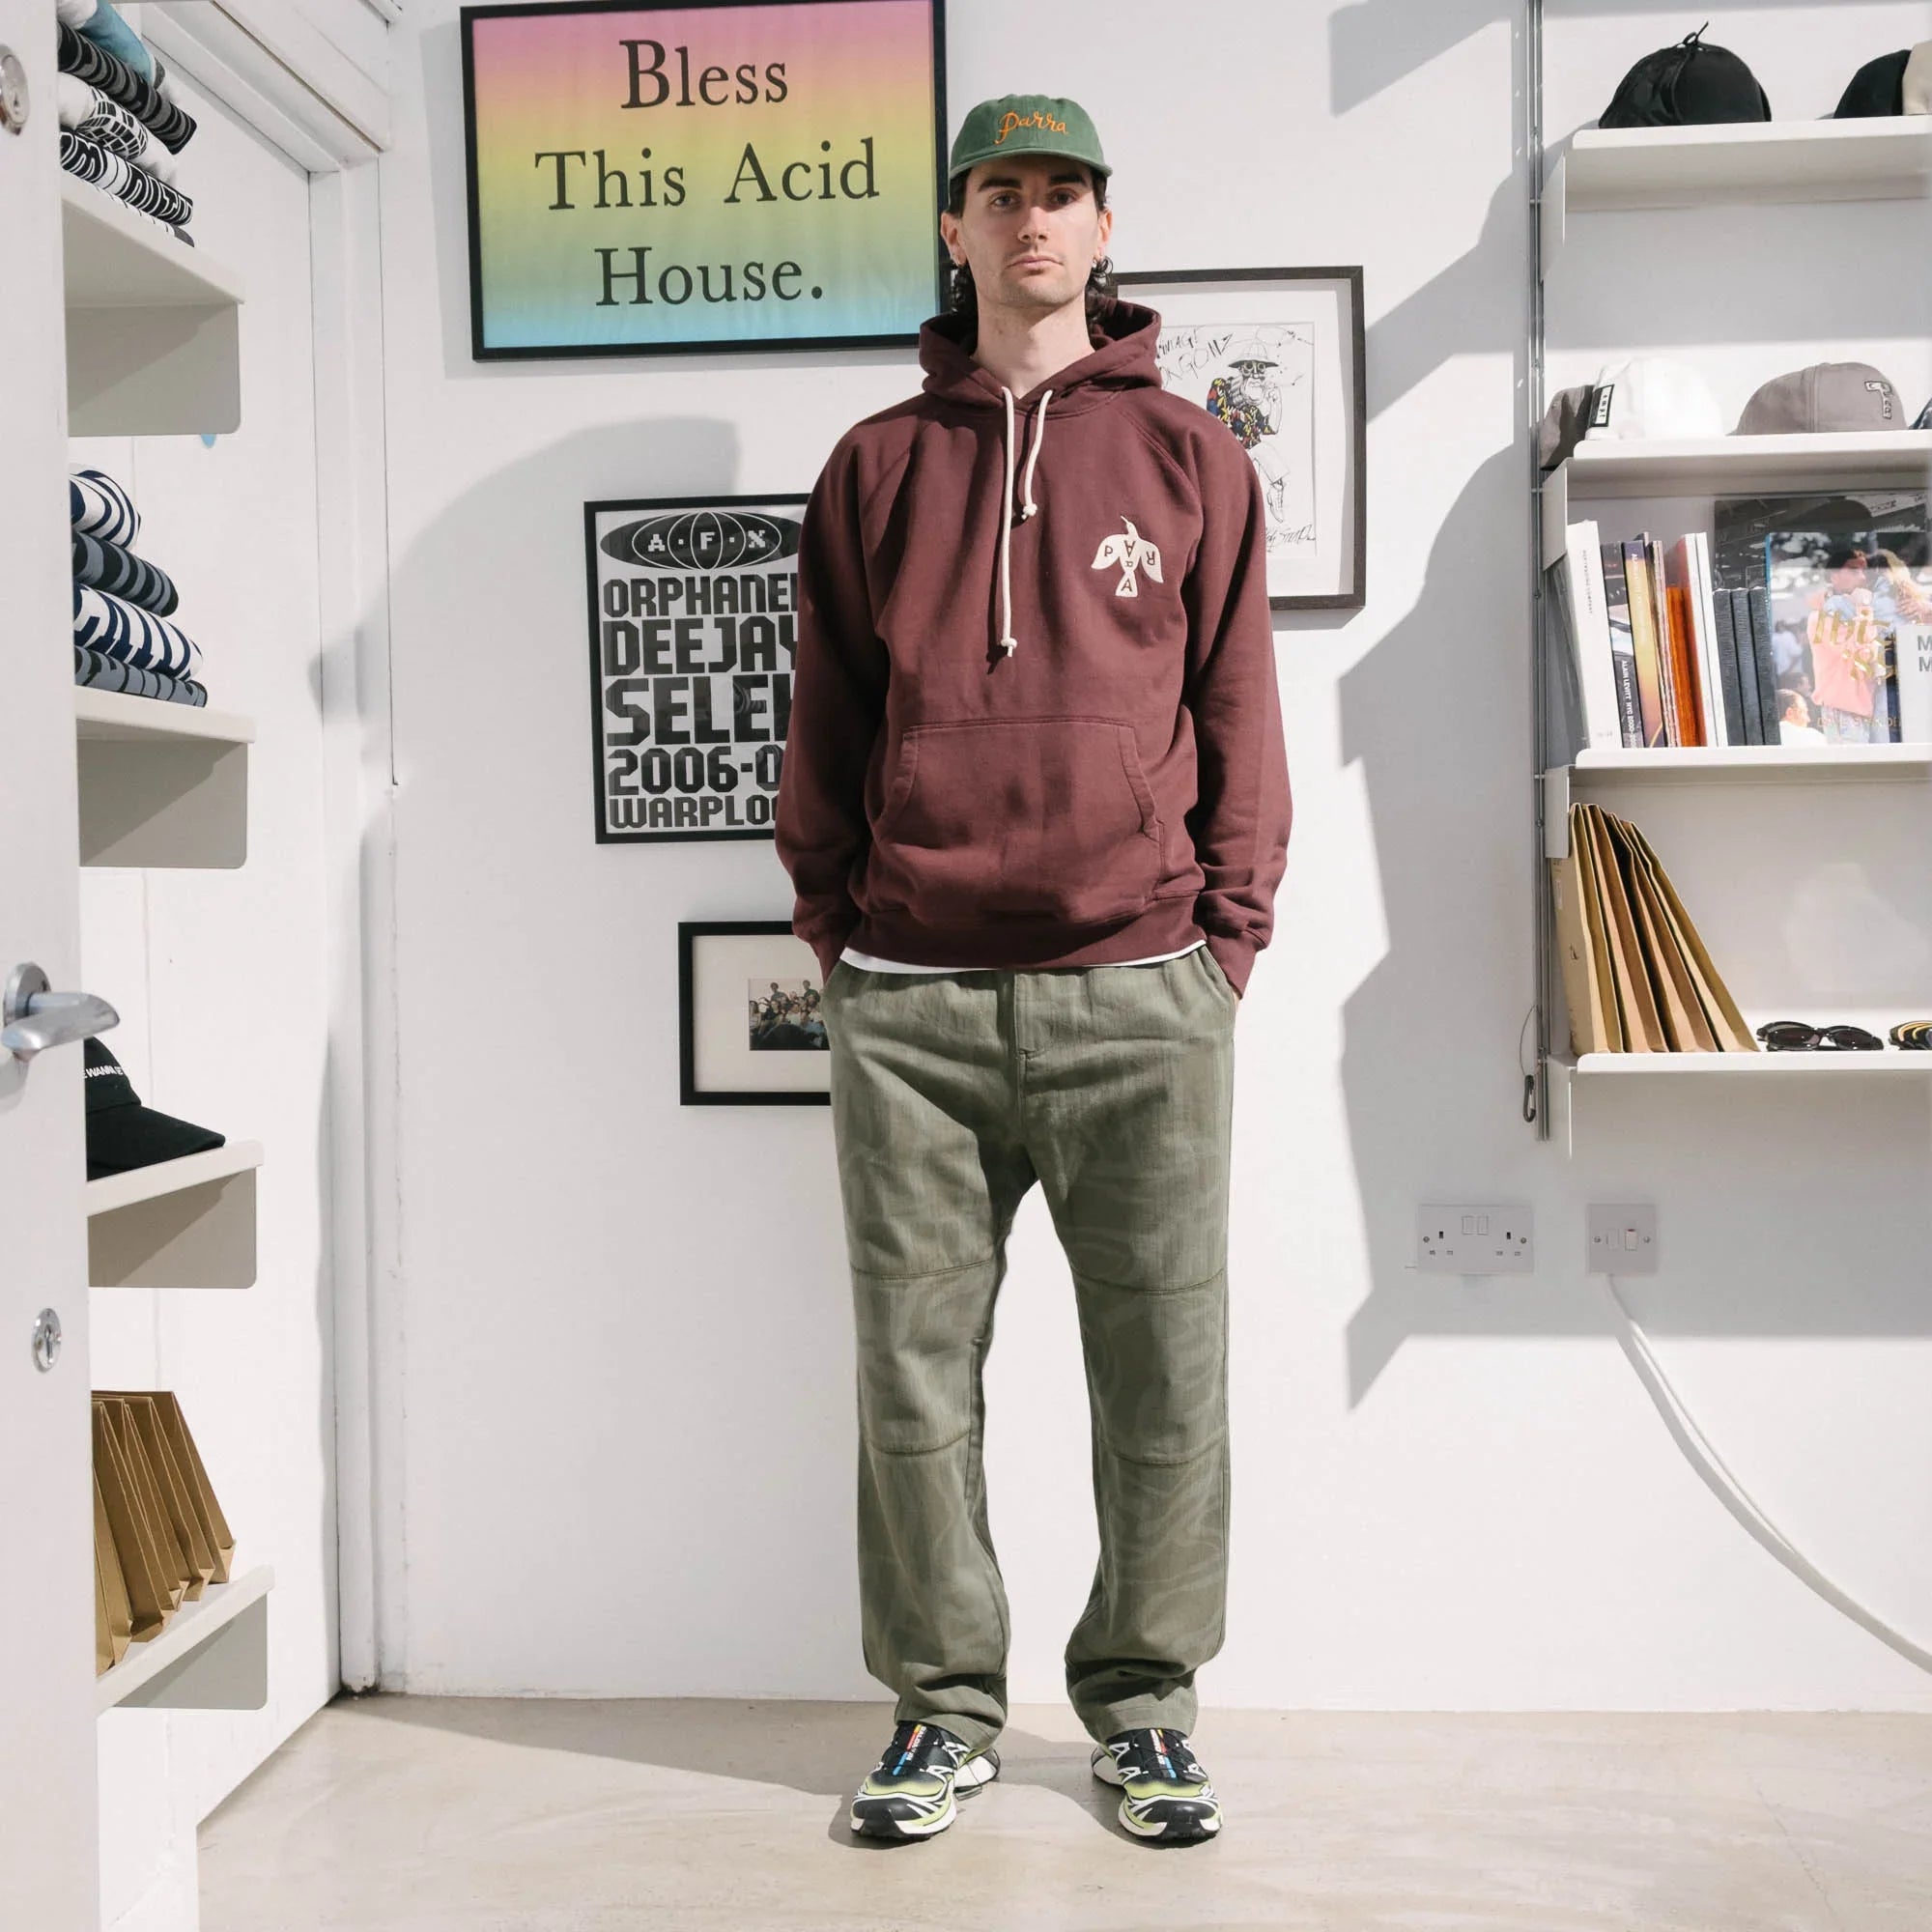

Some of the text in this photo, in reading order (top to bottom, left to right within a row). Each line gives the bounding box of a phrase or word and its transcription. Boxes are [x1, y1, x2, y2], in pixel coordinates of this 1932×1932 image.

[618, 39, 788, 109] Bless
[993, 110, 1068, 144] Parra
[534, 135, 880, 211] This Acid
[594, 245, 823, 306] House.
[609, 794, 780, 830] WARPLO
